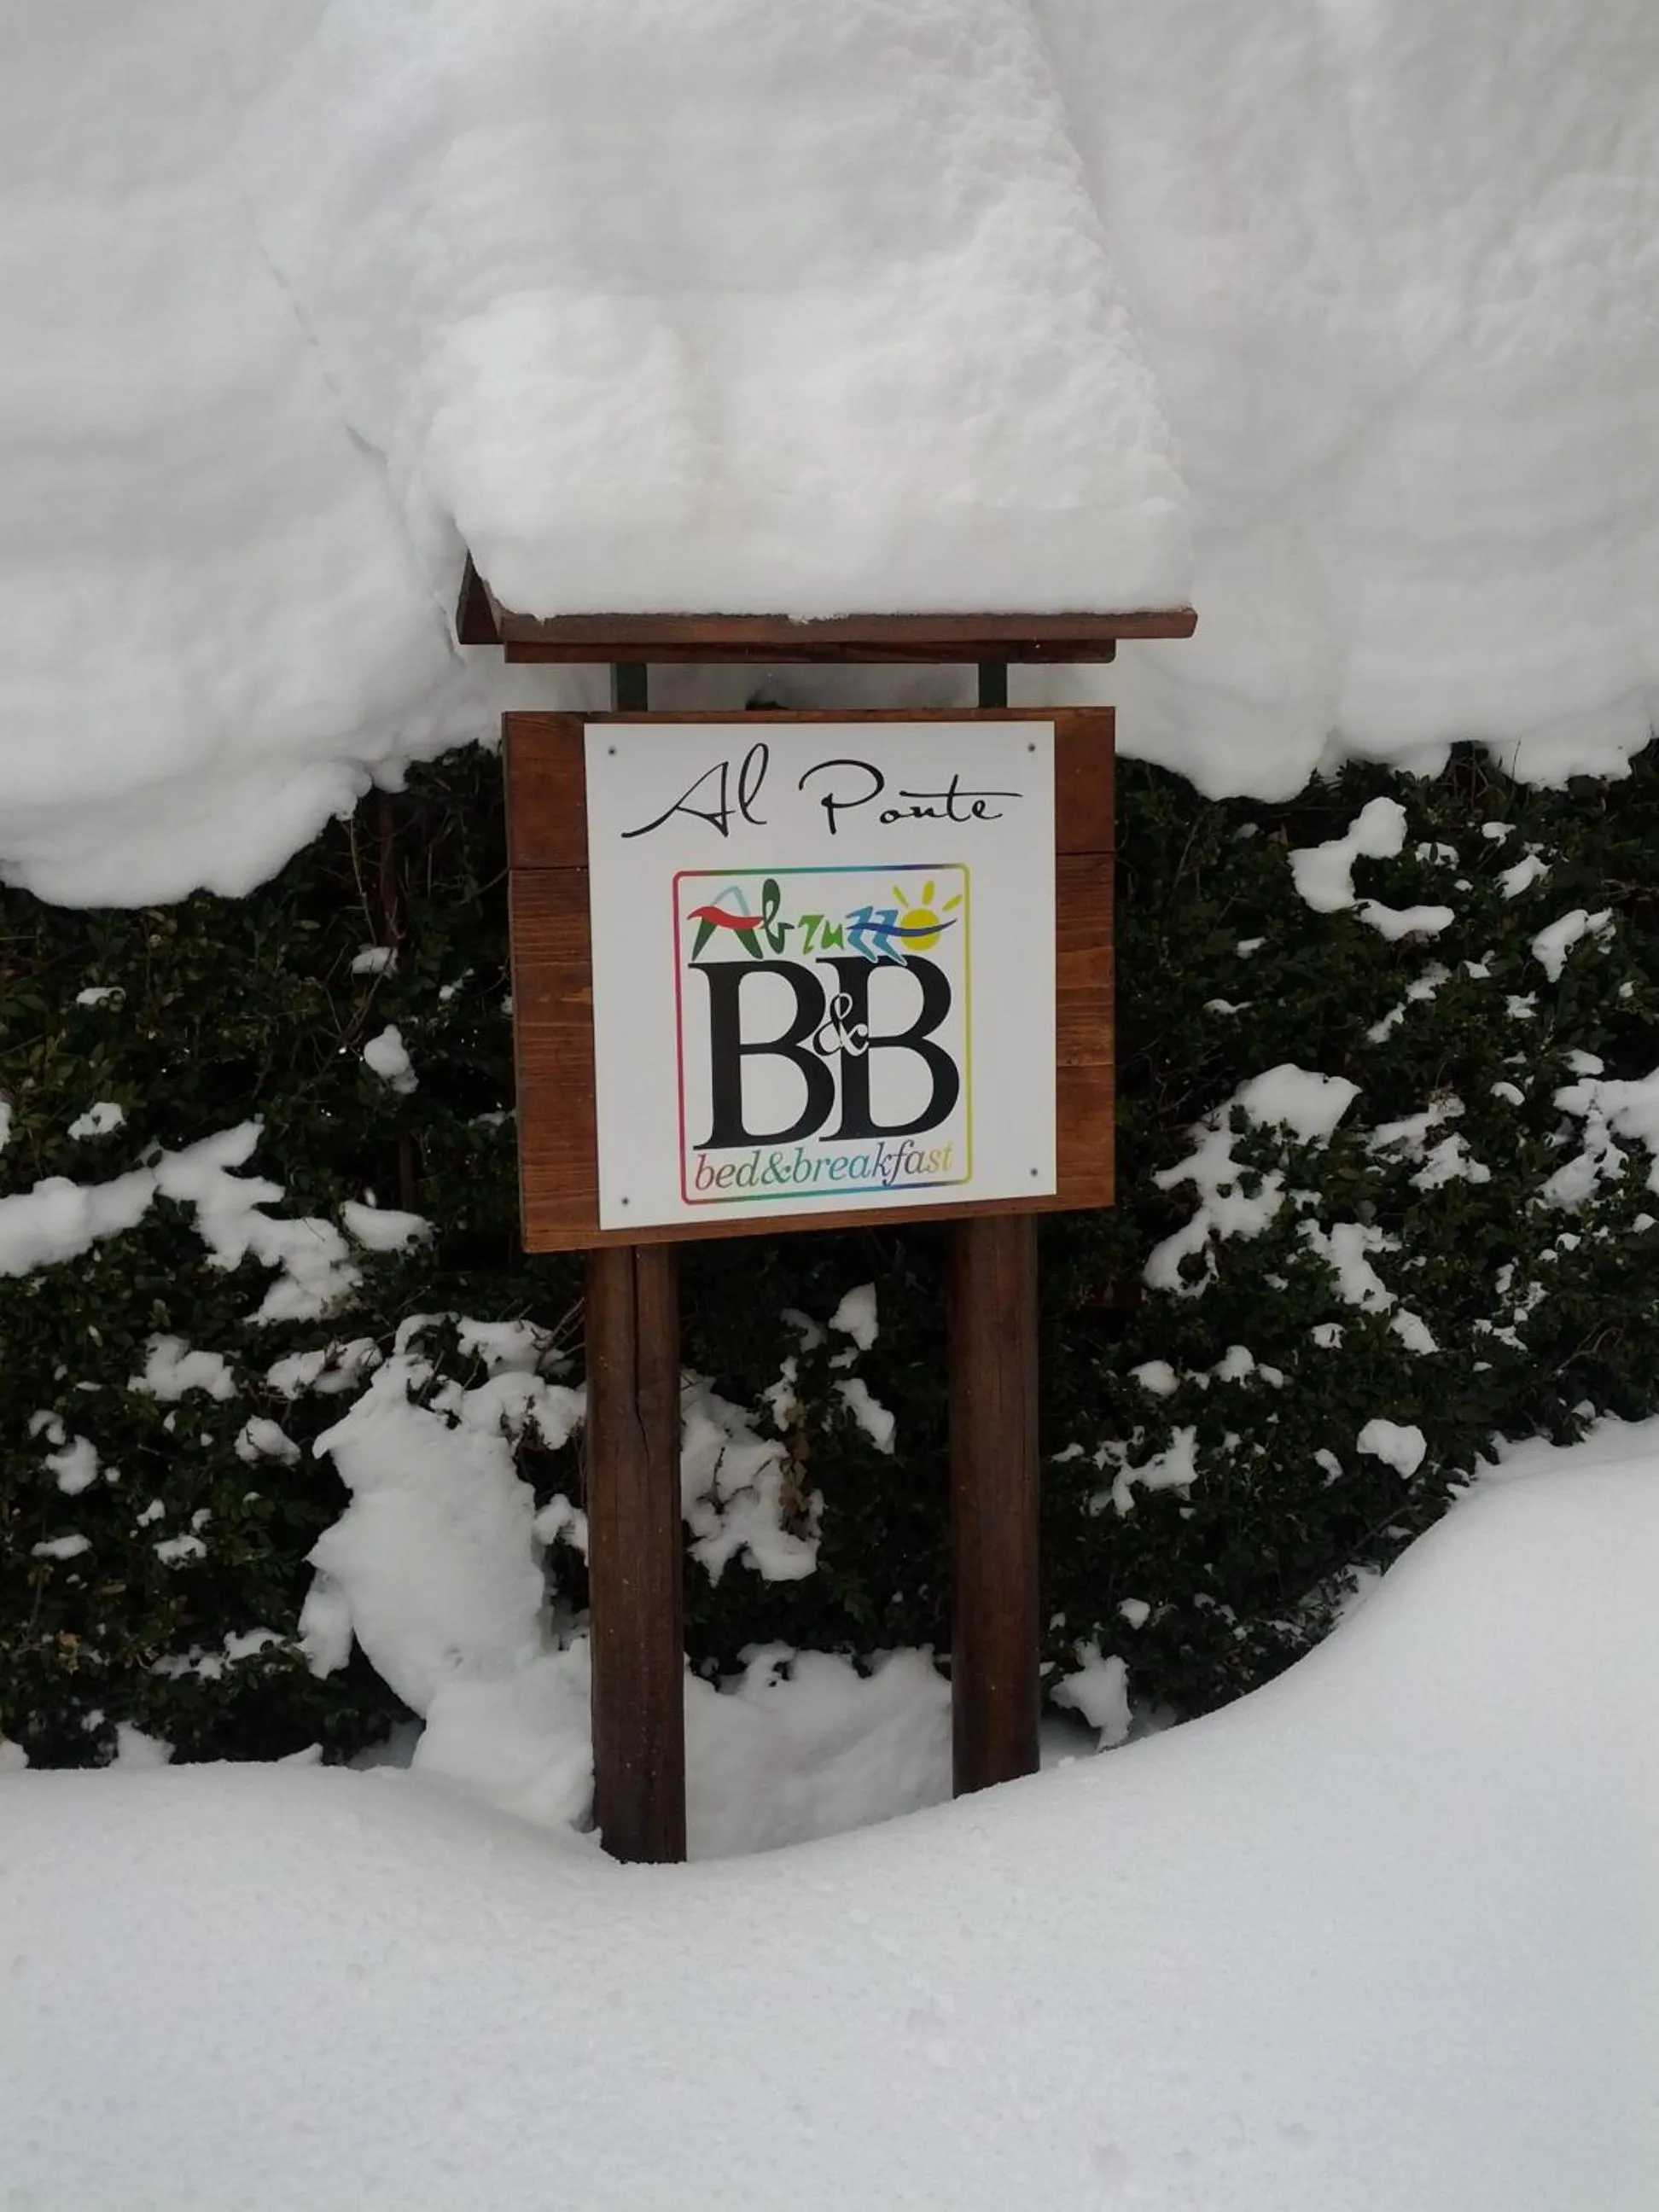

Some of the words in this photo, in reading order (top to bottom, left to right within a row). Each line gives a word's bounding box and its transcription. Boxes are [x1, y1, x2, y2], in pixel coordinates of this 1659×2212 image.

[621, 742, 769, 838] Al
[799, 759, 1022, 835] Ponte
[688, 954, 960, 1150] B&B
[694, 1139, 954, 1190] bed&breakfast
